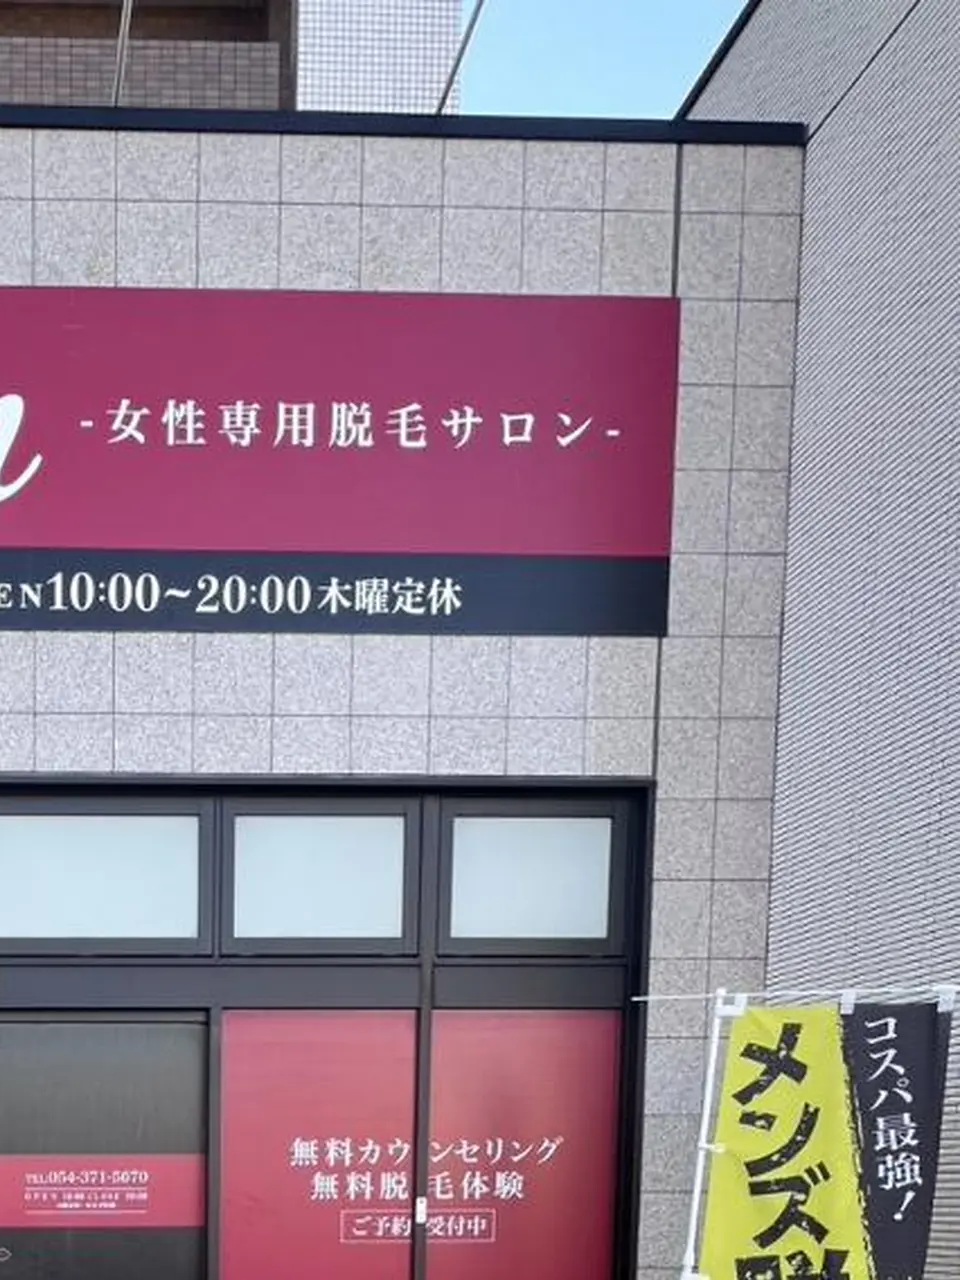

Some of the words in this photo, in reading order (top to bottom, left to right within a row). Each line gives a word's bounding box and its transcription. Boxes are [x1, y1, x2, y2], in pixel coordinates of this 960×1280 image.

[317, 576, 462, 615] 木曜定休
[310, 1171, 525, 1200] 無料脱毛体験
